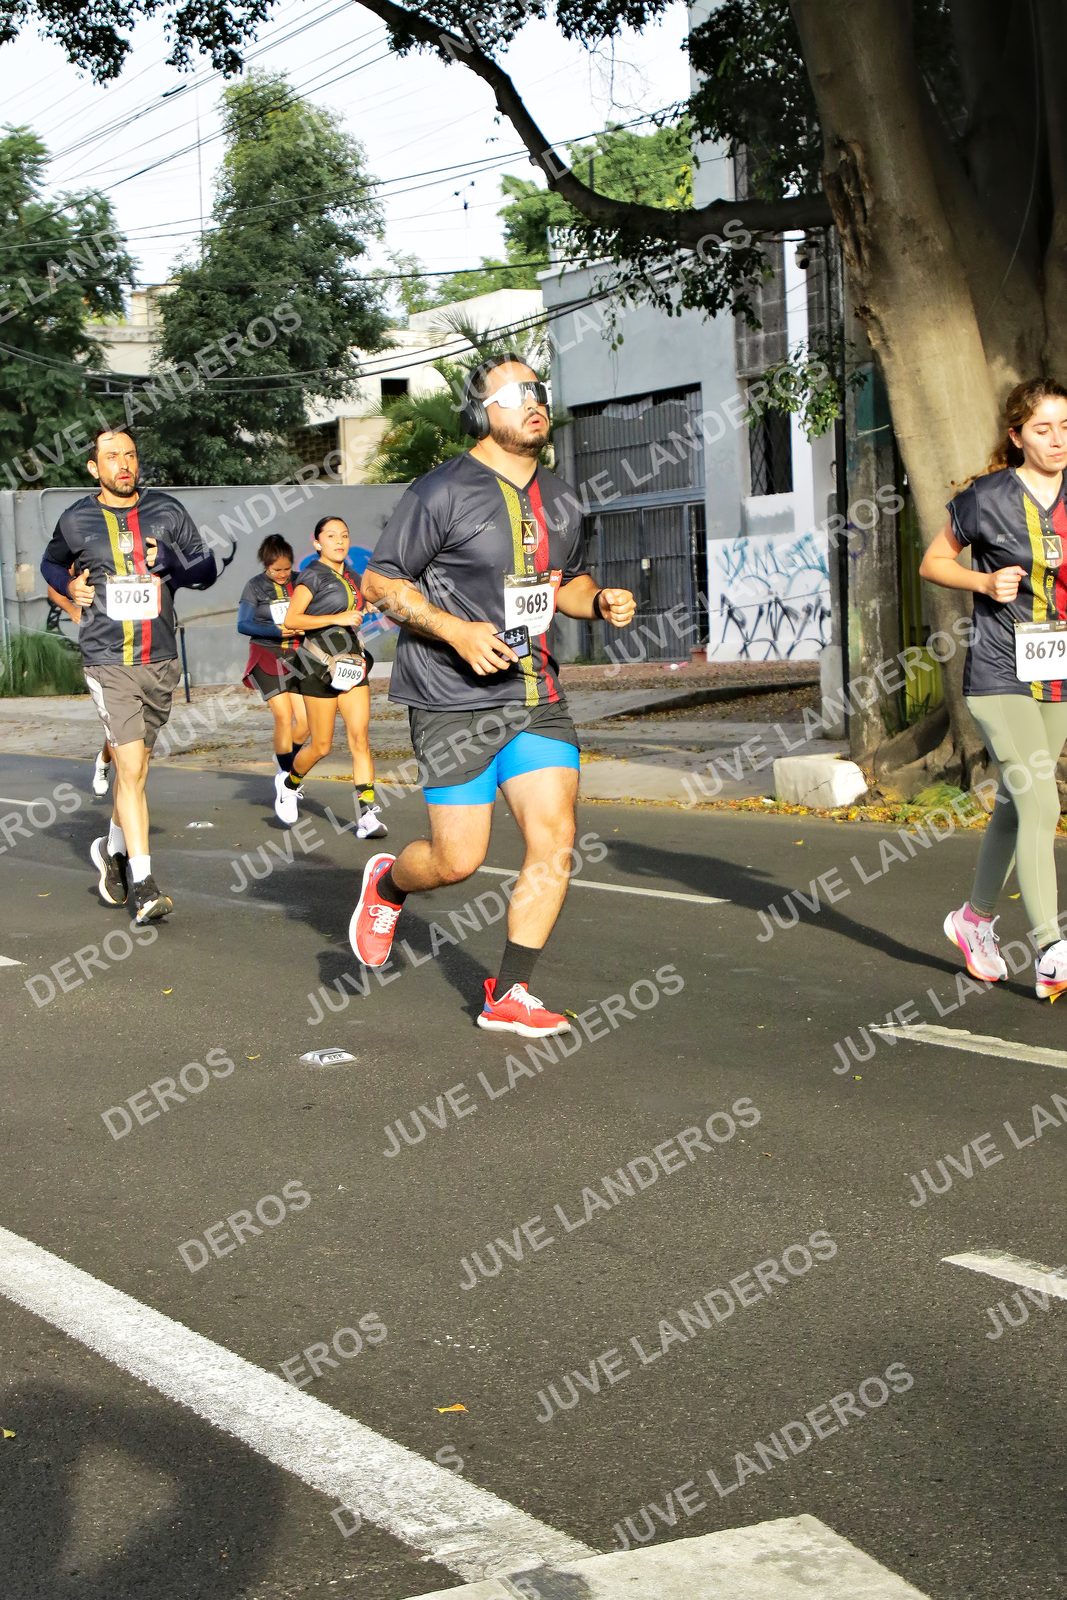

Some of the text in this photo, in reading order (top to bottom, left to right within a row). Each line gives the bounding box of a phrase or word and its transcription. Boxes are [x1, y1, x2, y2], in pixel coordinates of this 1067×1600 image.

[114, 589, 150, 604] 8705
[515, 591, 548, 615] 9693
[1025, 639, 1066, 660] 8679
[337, 666, 362, 680] 10989
